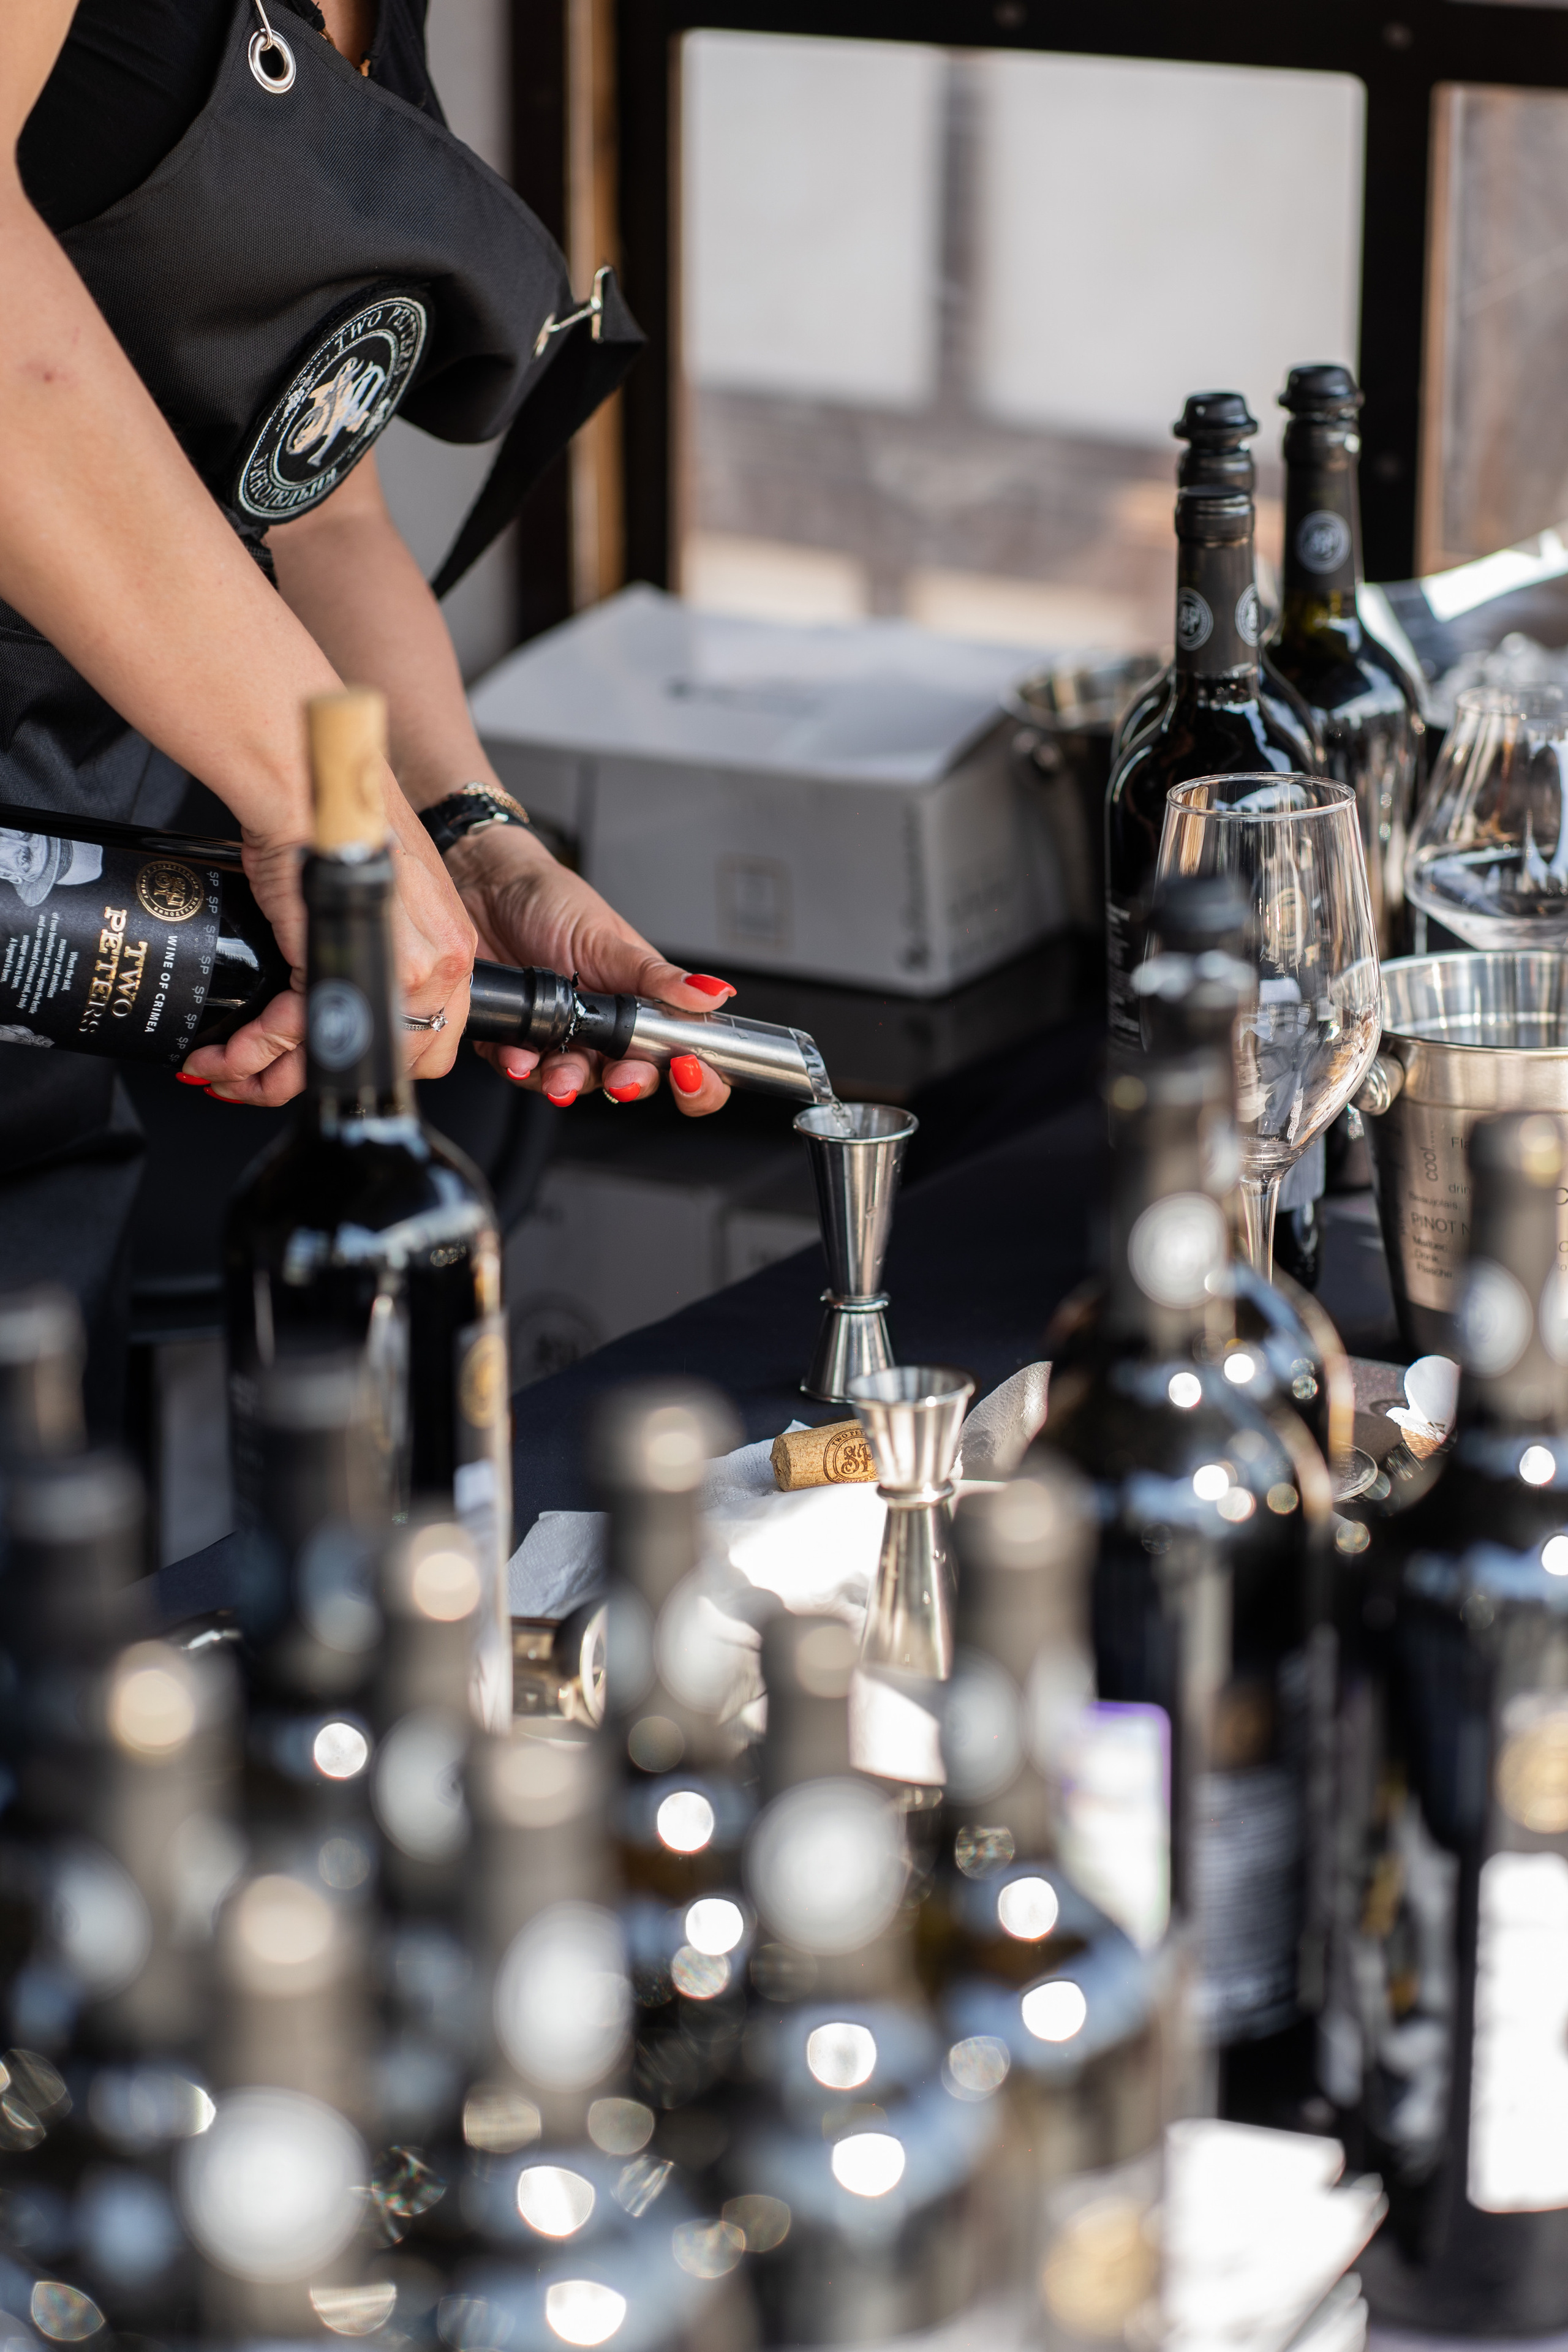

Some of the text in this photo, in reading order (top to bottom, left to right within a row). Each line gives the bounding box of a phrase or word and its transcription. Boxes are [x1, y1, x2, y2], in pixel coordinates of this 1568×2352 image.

[334, 311, 382, 352] TWO
[50, 920, 59, 932] two
[5, 943, 17, 963] legend
[19, 935, 29, 956] unique
[31, 927, 44, 960] sun-soaked
[45, 932, 57, 956] brothers
[16, 956, 26, 970] wine
[26, 960, 39, 983] Crimean
[40, 967, 50, 978] laid
[47, 939, 67, 998] mastery and ambition
[61, 952, 79, 991] When the skill,
[79, 907, 127, 1033] PETERS
[11, 976, 22, 989] born.
[21, 984, 31, 993] soil,
[36, 978, 45, 992] upon
[111, 941, 148, 1019] TWO
[145, 935, 178, 1032] WINE OF CRIMEA
[16, 998, 28, 1009] truly
[29, 1000, 40, 1014] fertile
[1411, 1212, 1457, 1235] PINOT
[832, 1433, 848, 1446] TWO
